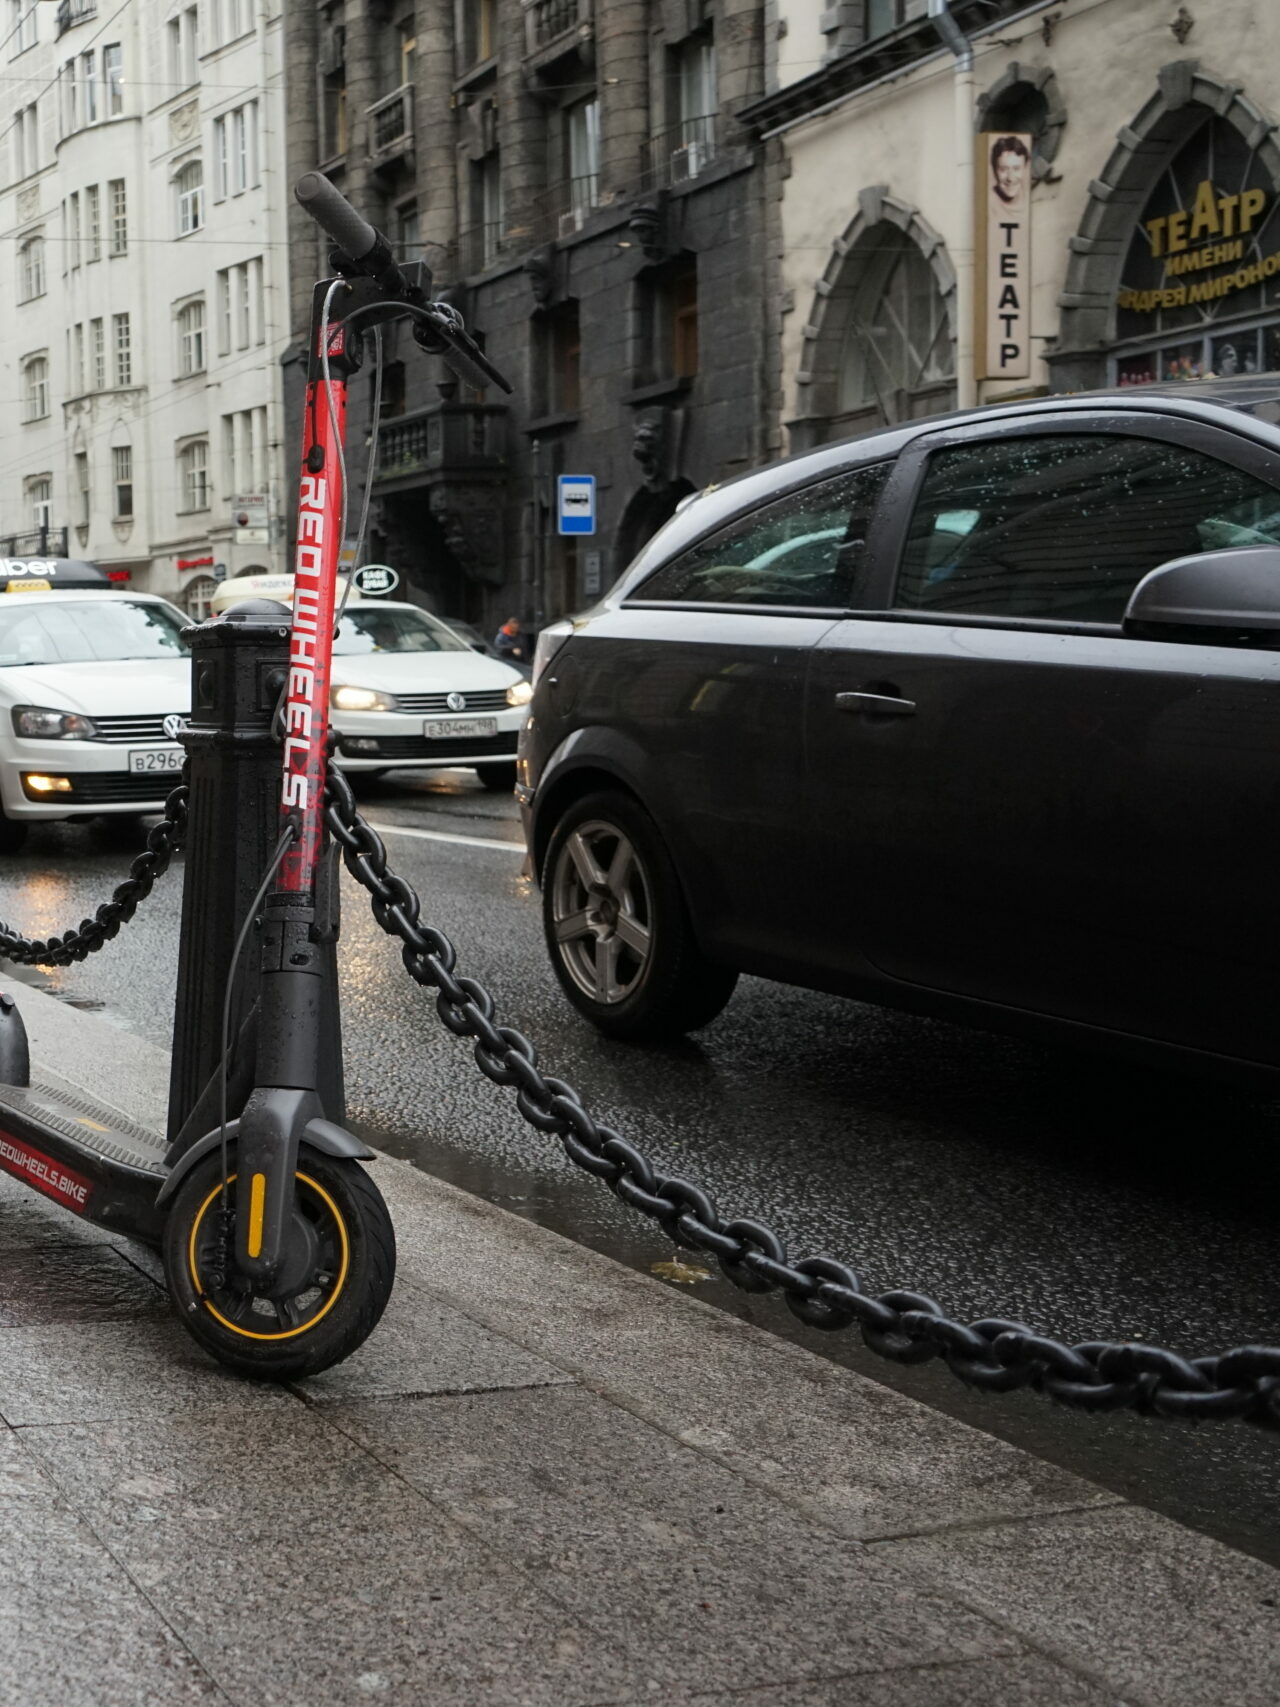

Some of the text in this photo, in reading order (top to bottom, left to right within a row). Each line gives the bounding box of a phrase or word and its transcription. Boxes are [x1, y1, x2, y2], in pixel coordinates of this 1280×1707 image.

[1145, 179, 1266, 259] ТЕАТР
[1164, 239, 1243, 277] ИМЕНИ
[1188, 252, 1280, 304] МИРОНО
[998, 222, 1020, 369] ТЕАТР
